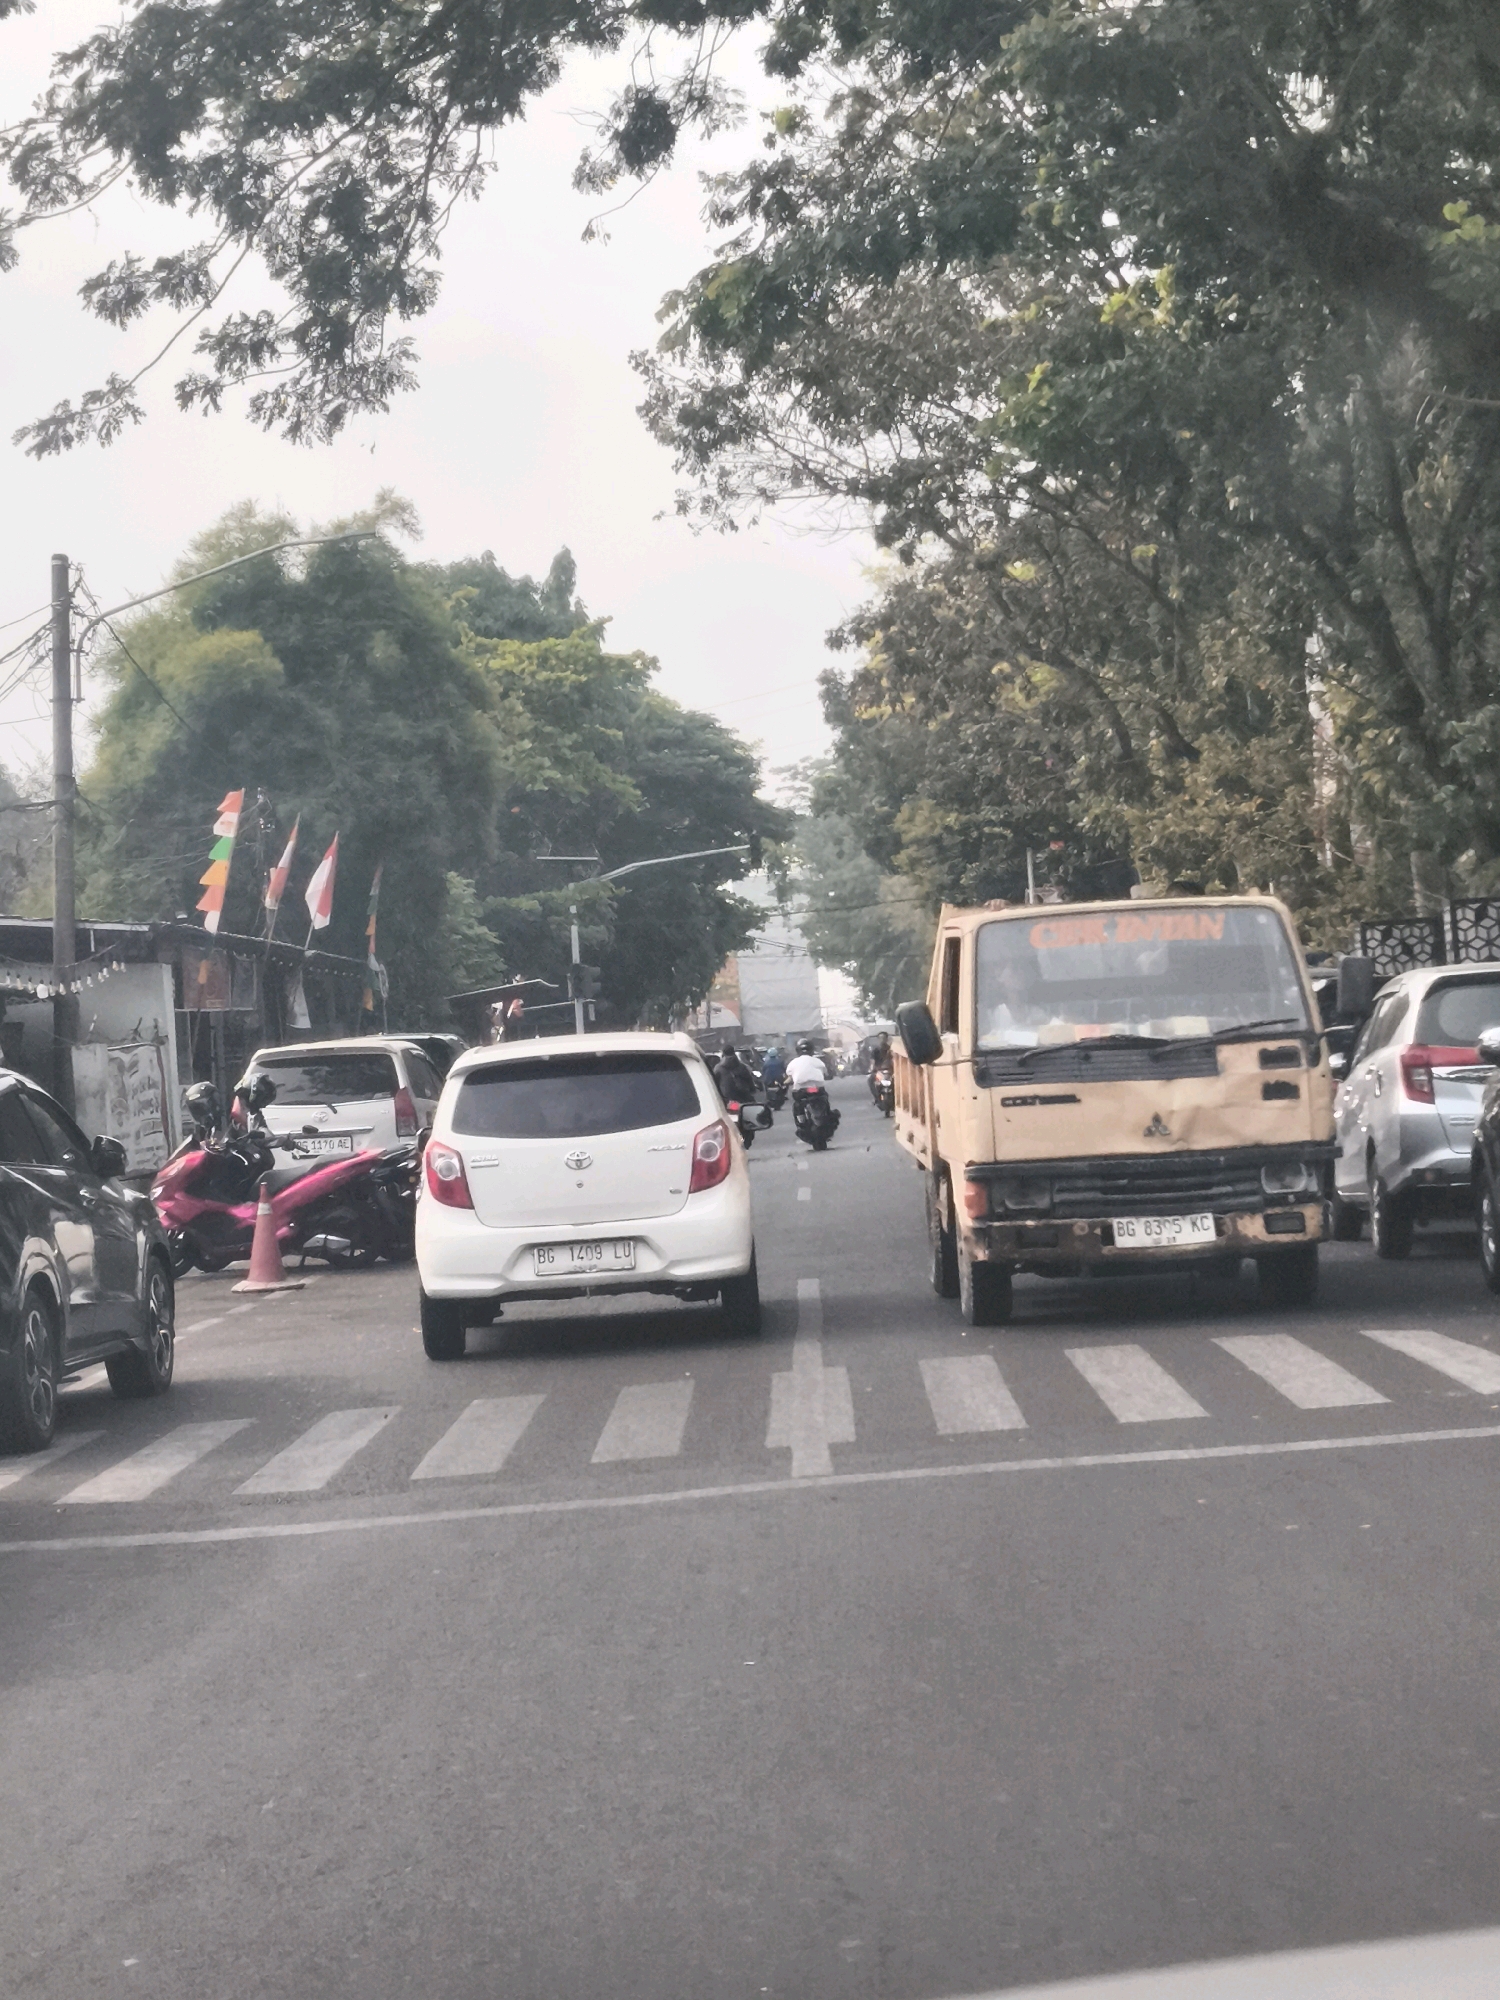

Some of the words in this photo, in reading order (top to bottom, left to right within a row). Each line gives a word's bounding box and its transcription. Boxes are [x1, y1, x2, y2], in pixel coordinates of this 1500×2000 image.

[1116, 1220, 1136, 1237] BG
[1190, 1215, 1211, 1232] KC
[537, 1247, 555, 1264] BG
[569, 1243, 603, 1262] 1409
[614, 1241, 632, 1259] LU
